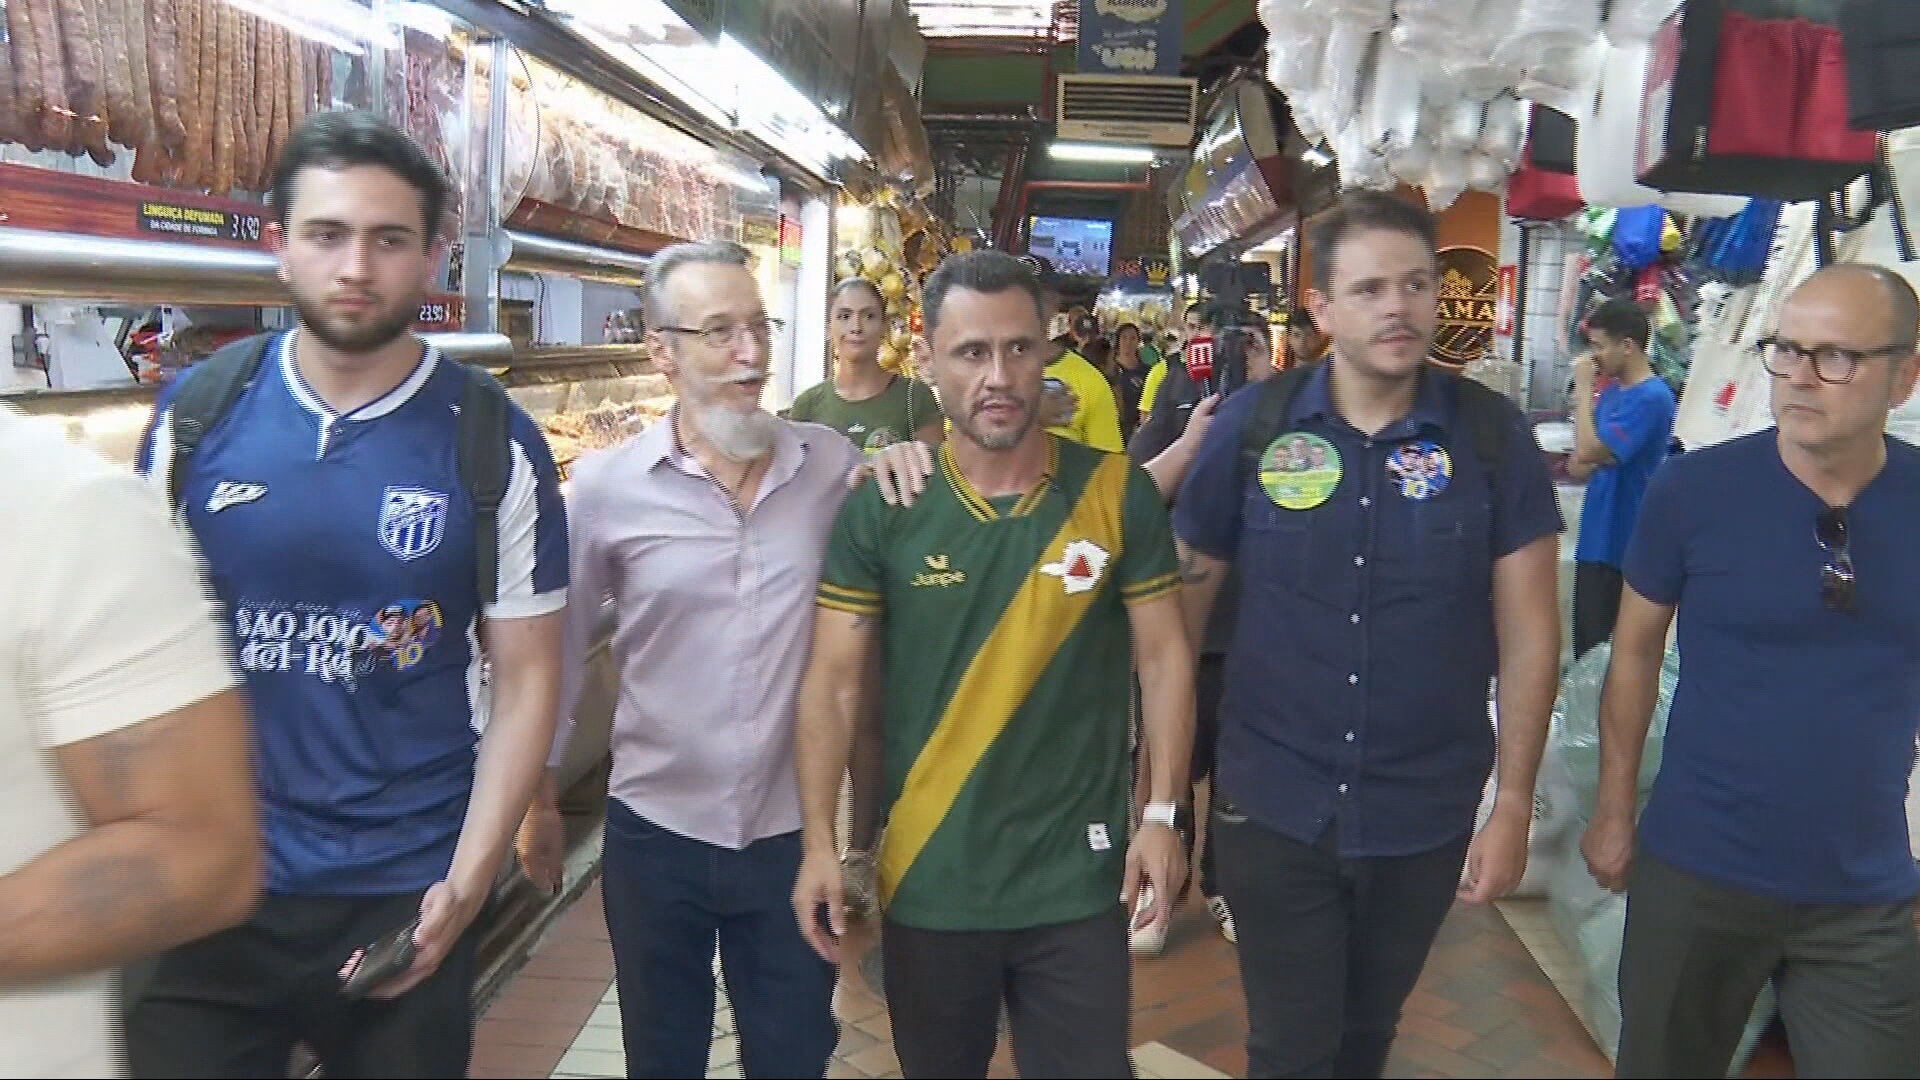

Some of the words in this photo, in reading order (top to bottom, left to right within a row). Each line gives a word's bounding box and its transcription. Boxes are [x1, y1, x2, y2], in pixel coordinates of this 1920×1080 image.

[143, 203, 182, 221] LINGUIÇA
[183, 208, 224, 225] DEFUMADA
[1436, 300, 1494, 320] AMA
[394, 641, 424, 669] 10
